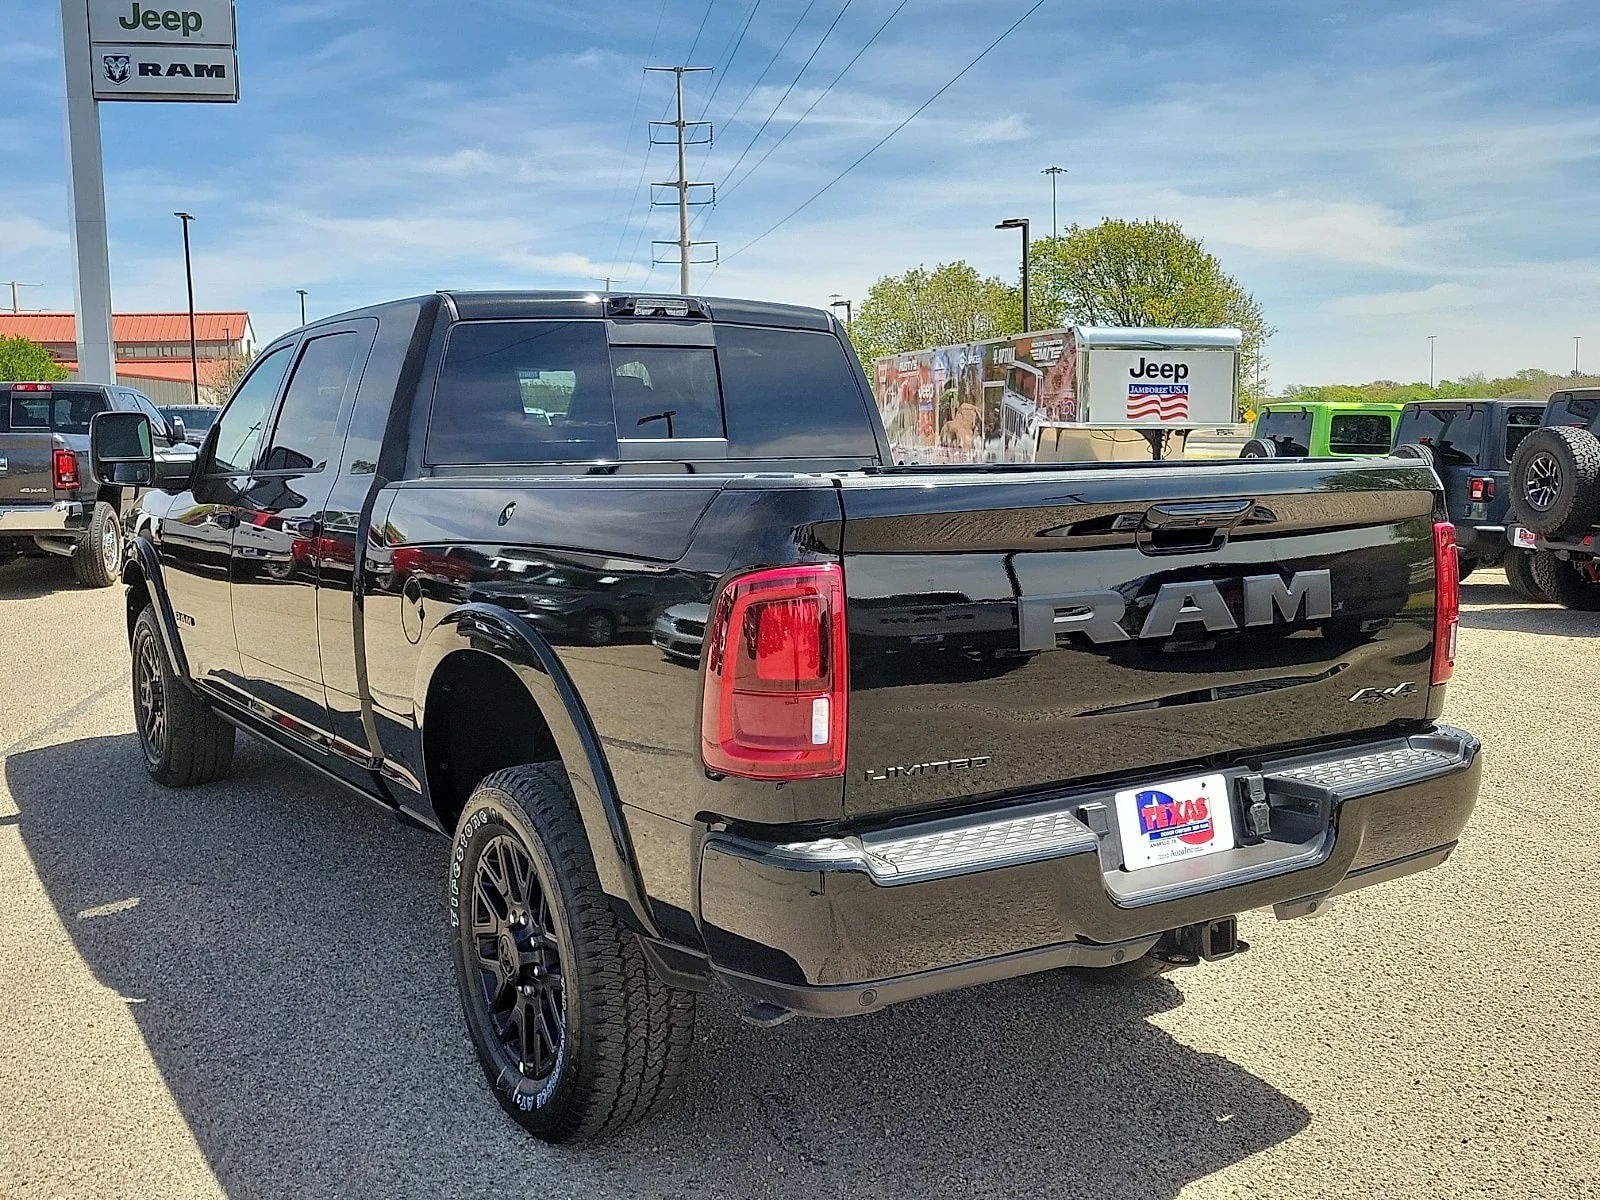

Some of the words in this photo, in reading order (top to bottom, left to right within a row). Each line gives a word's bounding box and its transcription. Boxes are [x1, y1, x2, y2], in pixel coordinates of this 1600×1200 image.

[118, 2, 203, 37] Jeep
[138, 63, 226, 78] RAM
[1129, 357, 1189, 383] Jeep
[1169, 385, 1188, 394] USA
[1018, 568, 1332, 652] RAM
[864, 756, 992, 781] LIMITED
[1141, 797, 1209, 831] TEXAS
